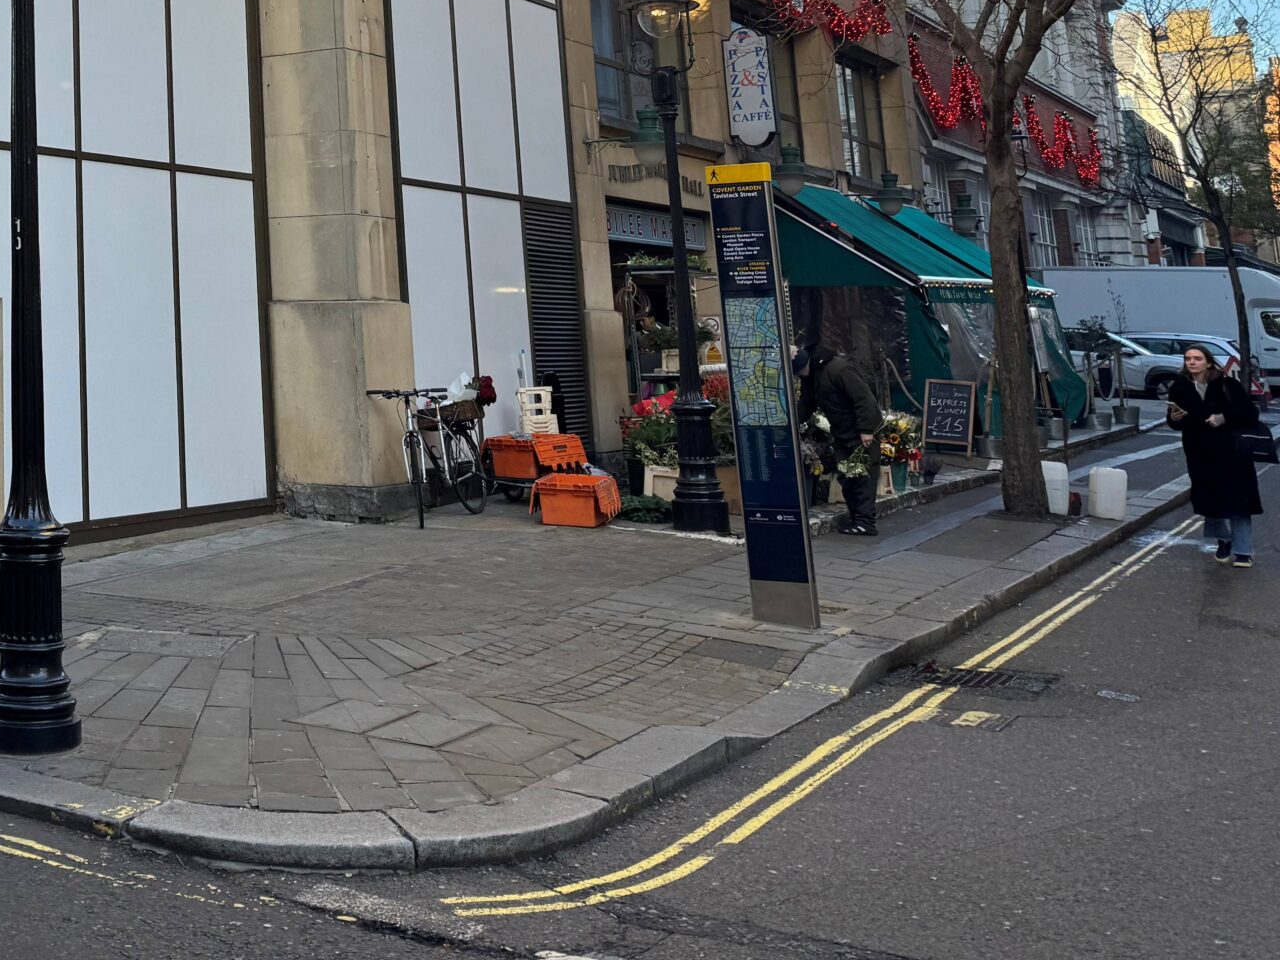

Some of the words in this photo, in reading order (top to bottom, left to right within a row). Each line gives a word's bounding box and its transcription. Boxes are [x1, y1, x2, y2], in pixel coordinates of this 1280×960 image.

[729, 49, 742, 111] PIZZA
[755, 46, 770, 109] PASTA
[936, 406, 967, 415] LUNCH
[928, 416, 965, 431] £15
